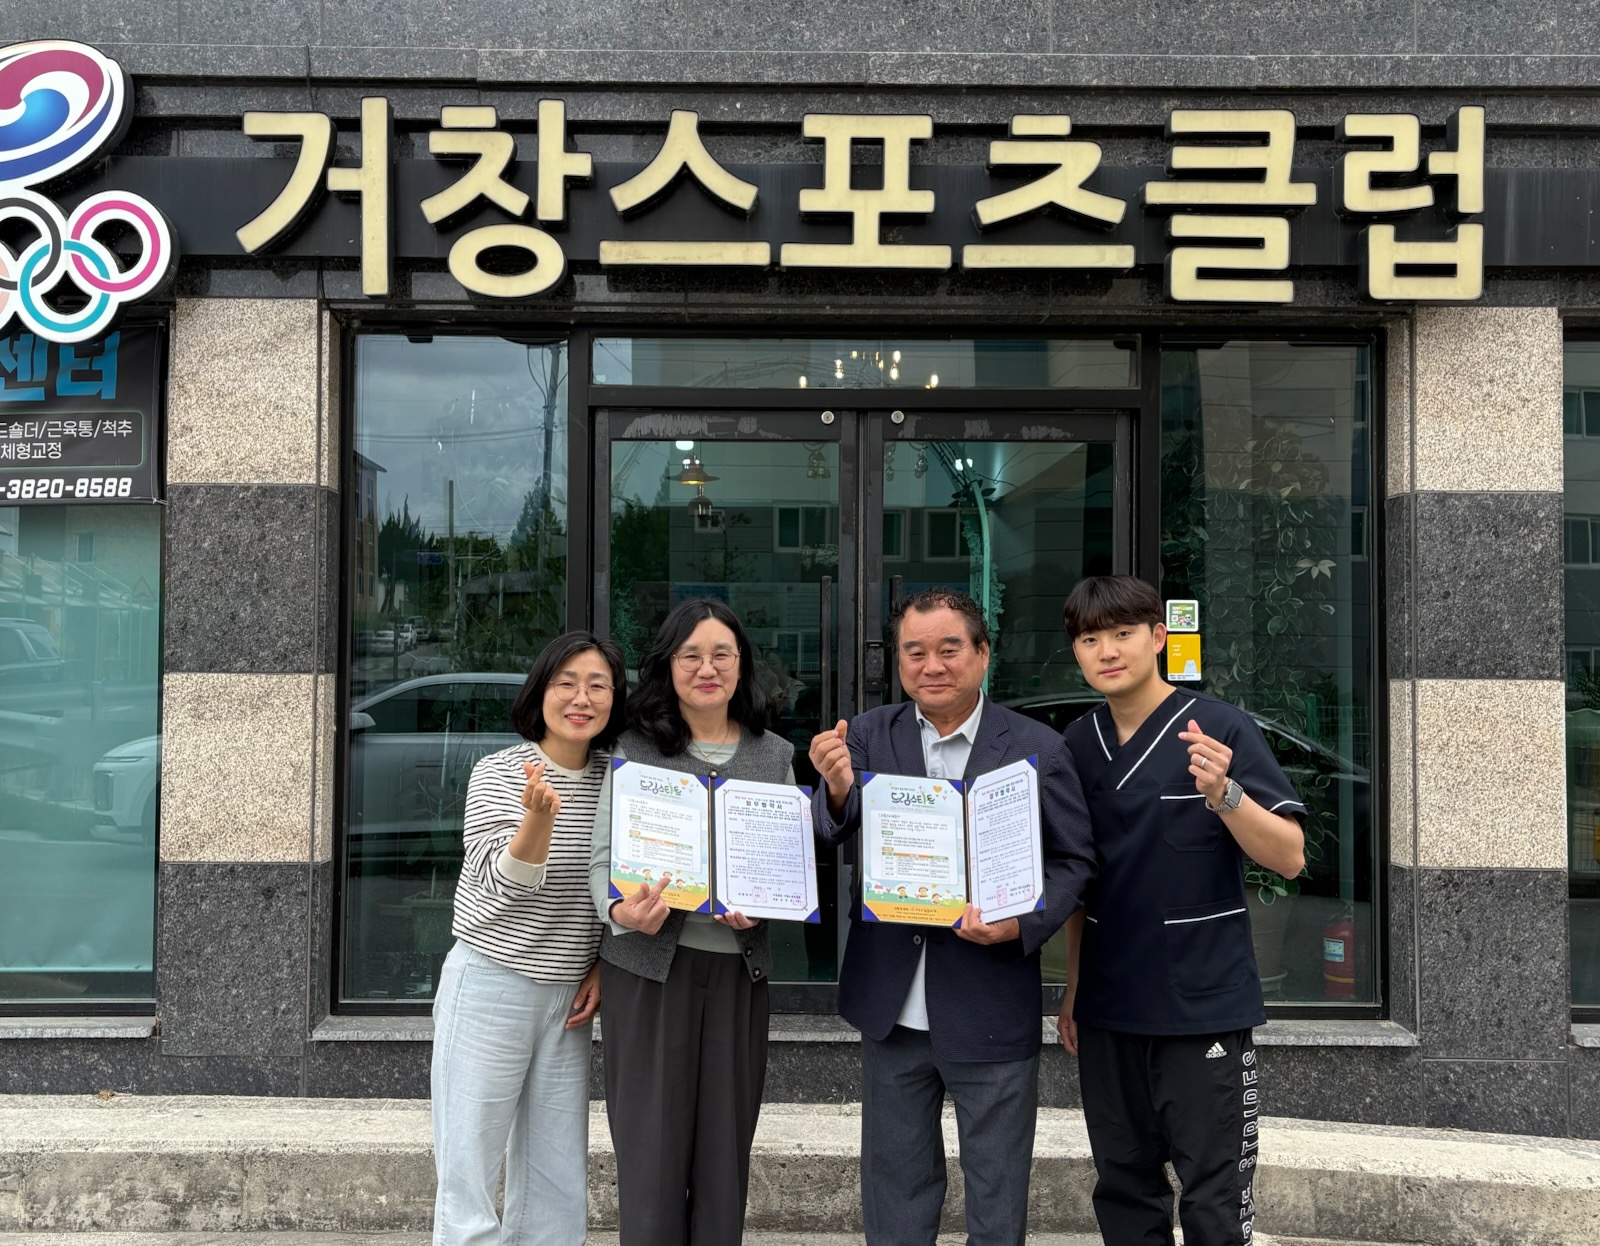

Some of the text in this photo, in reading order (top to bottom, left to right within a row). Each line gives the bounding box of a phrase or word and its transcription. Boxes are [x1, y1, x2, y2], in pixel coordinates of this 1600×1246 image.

[236, 96, 1485, 303] 거창스포츠클럽
[0, 442, 62, 460] 체형교정
[1205, 1051, 1227, 1059] adidas
[1239, 1181, 1255, 1246] REE
